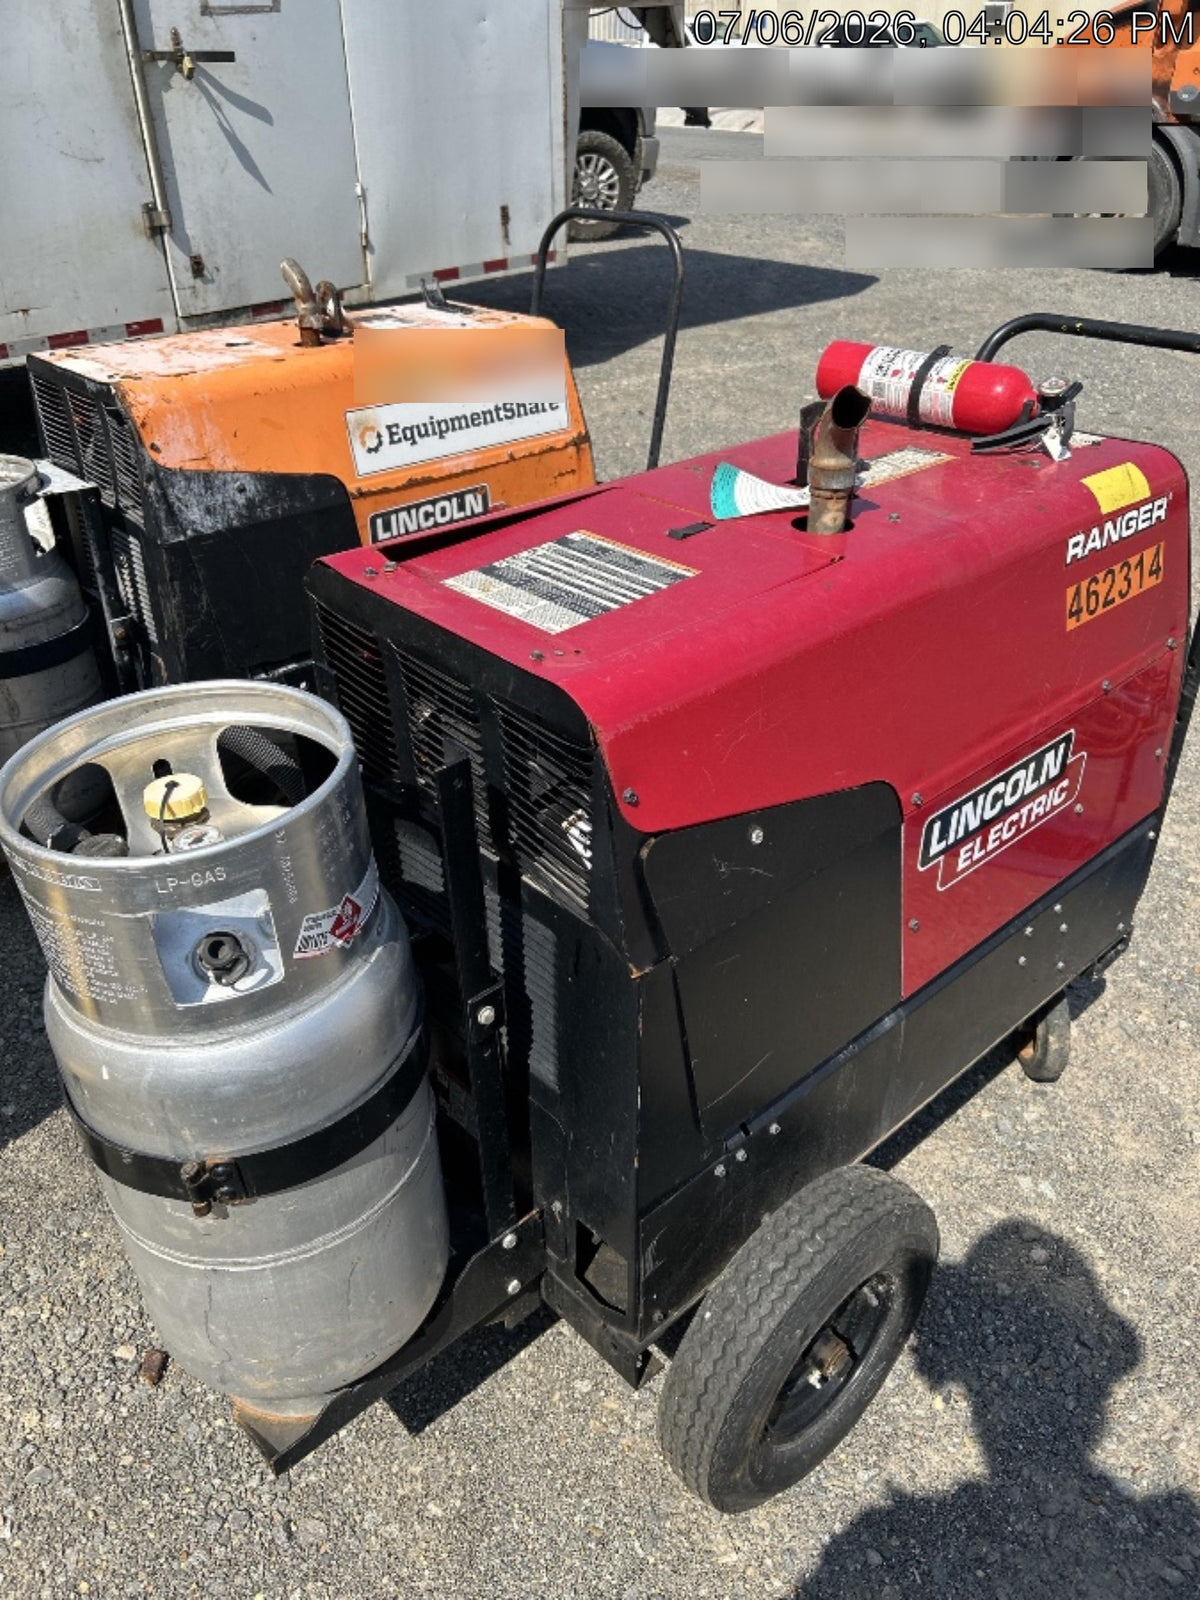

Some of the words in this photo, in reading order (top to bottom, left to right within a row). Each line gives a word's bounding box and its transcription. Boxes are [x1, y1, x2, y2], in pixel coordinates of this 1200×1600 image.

[375, 493, 485, 541] LINCOLN
[1065, 497, 1168, 566] RANGER
[1068, 544, 1162, 623] 462314
[929, 743, 1066, 857] LINCOLN
[956, 779, 1070, 872] ELECTRIC
[156, 867, 227, 893] LP-GAS
